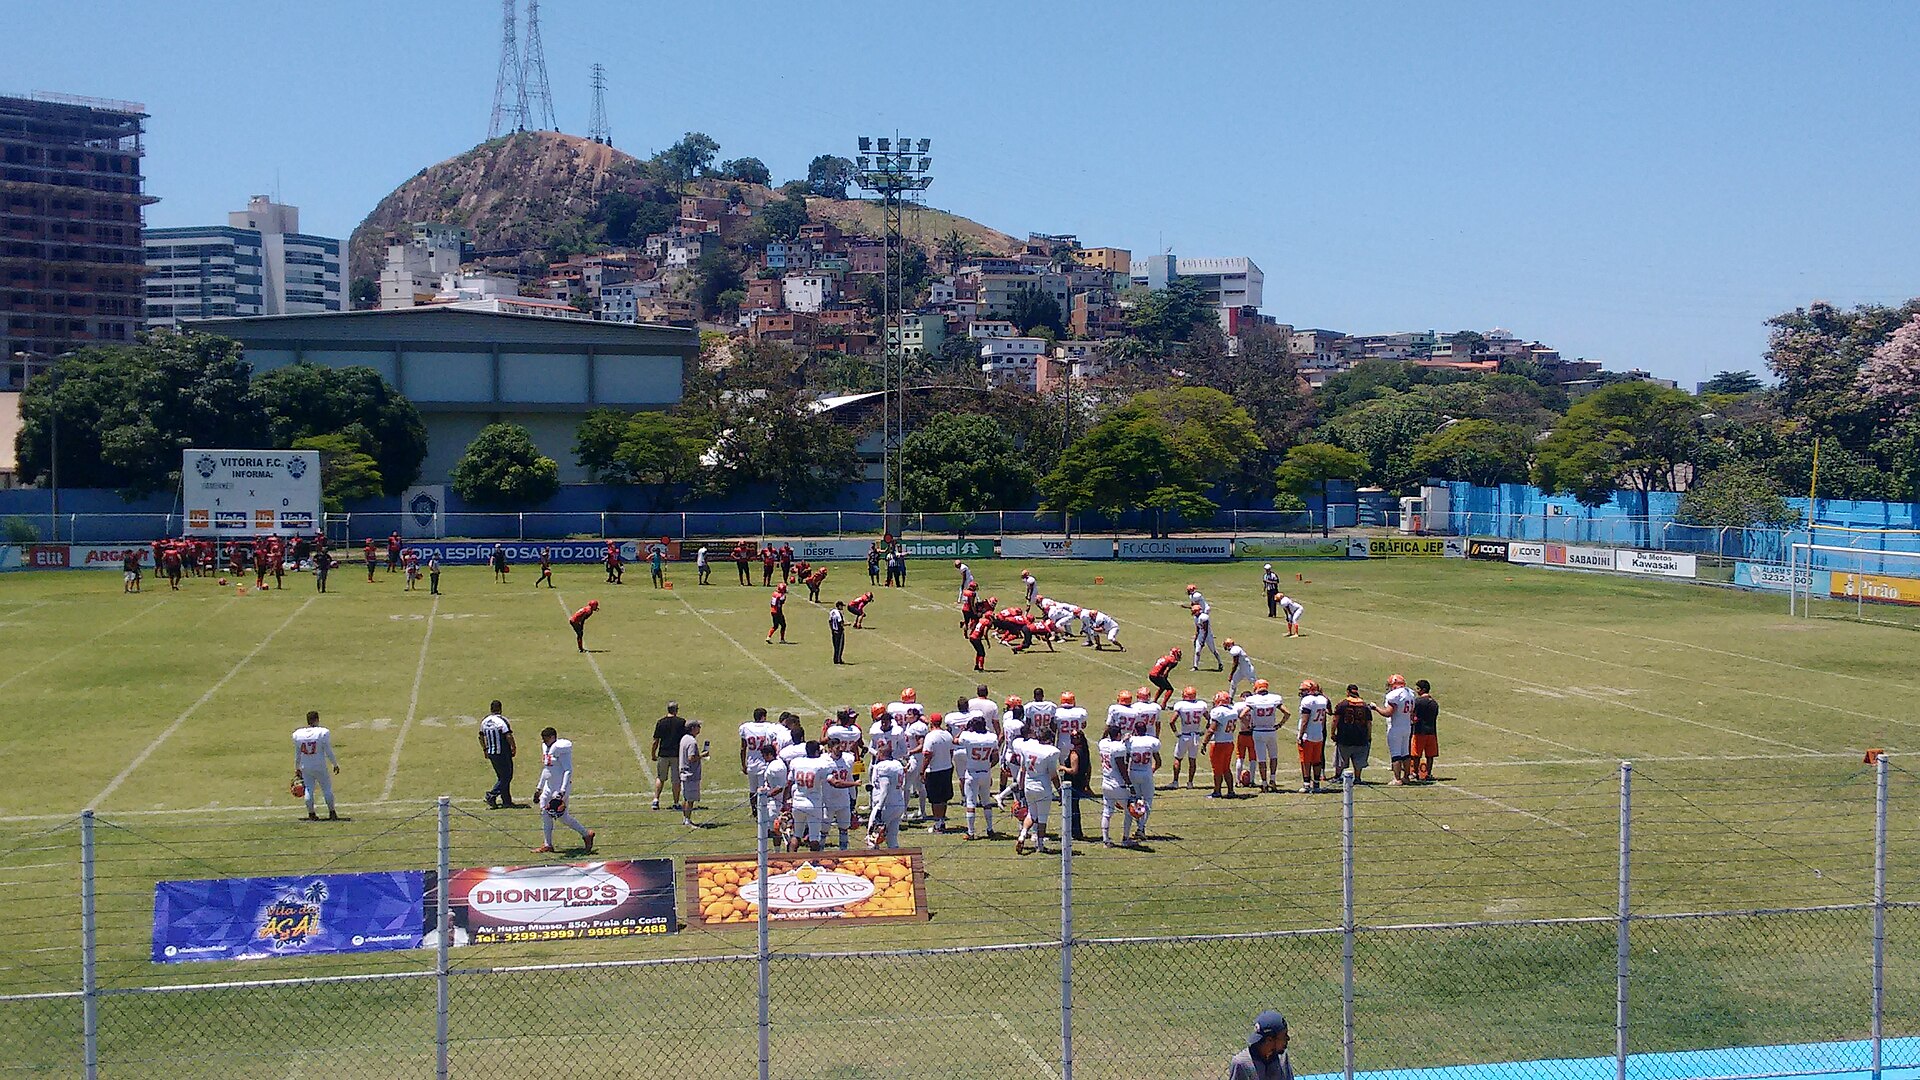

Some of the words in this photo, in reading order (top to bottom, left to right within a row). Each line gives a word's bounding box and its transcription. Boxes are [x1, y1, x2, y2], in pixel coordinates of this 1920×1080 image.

[220, 456, 264, 468] VITÓRIA
[266, 458, 284, 468] F.C.
[232, 470, 274, 479] INFORMA:
[215, 497, 220, 506] 1
[282, 498, 289, 507] 0
[895, 542, 957, 555] Unimed
[1042, 541, 1064, 549] VIX
[1123, 542, 1171, 554] FOCCUS
[1370, 540, 1420, 553] GRÁFICA
[1422, 541, 1444, 553] JEP
[803, 547, 835, 556] IDESPE
[1649, 553, 1673, 562] Motos
[1569, 554, 1610, 567] SABADINI
[1632, 558, 1678, 571] Kawasaki
[1761, 573, 1813, 585] 3232-000
[1786, 568, 1814, 578] SSTEM
[1184, 711, 1202, 725] 15
[972, 747, 992, 761] 57
[476, 884, 619, 905] DIONIZIO'S
[783, 877, 869, 904] Coxinha
[563, 898, 618, 909] Lanches
[477, 926, 494, 934] Av.
[497, 924, 526, 934] Hugo
[528, 923, 566, 932] Musso,
[567, 921, 591, 929] 850,
[593, 919, 620, 928] Praia
[622, 918, 636, 926] da
[638, 916, 668, 925] Costa
[476, 934, 500, 944] Tel:
[504, 929, 576, 942] 3299-3999
[587, 925, 668, 938] 99966-2488
